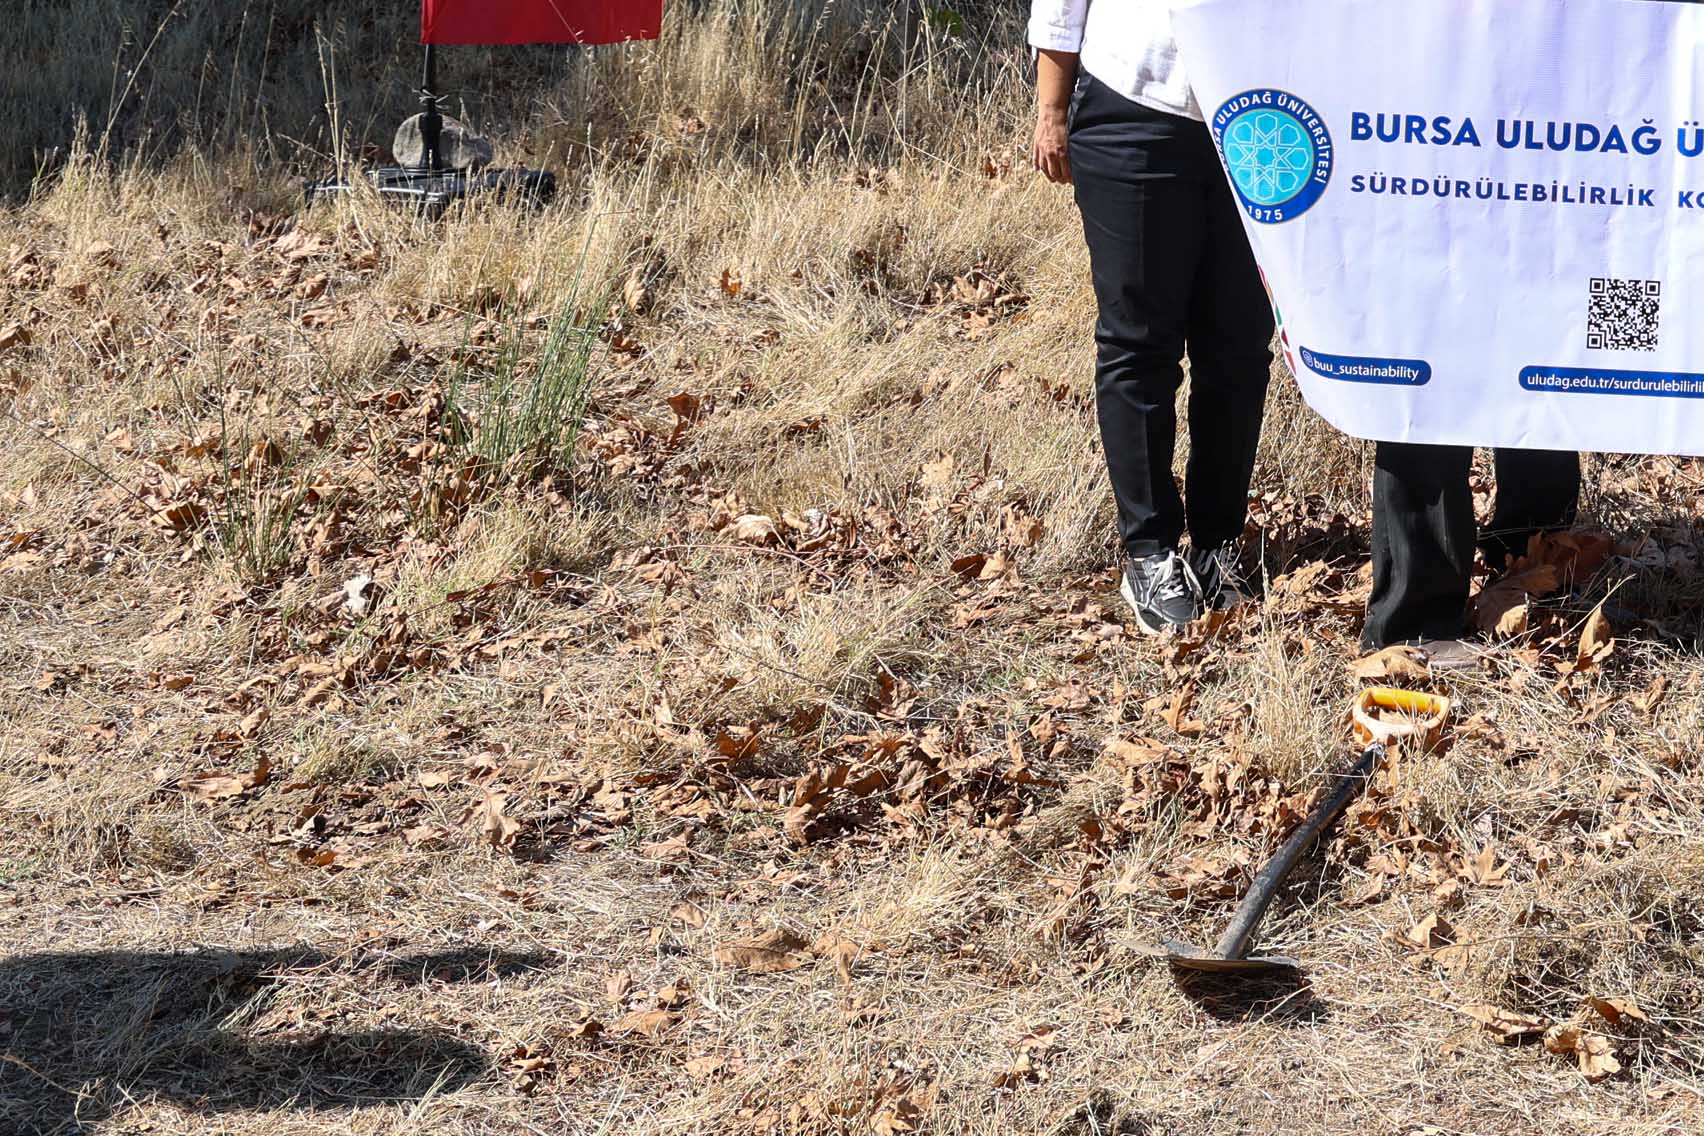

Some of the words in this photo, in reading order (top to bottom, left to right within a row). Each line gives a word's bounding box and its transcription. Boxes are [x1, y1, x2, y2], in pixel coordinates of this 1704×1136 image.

[1216, 91, 1273, 126] ULUDAĞ
[1277, 93, 1331, 184] ÜNİVERSİTESİ
[1350, 111, 1482, 148] BURSA
[1496, 117, 1662, 156] ULUDAĞ
[1350, 171, 1656, 207] SÜRDÜRÜLEBİLİRLİK
[1247, 205, 1284, 221] 1975
[1313, 357, 1420, 382] buu_sustainability
